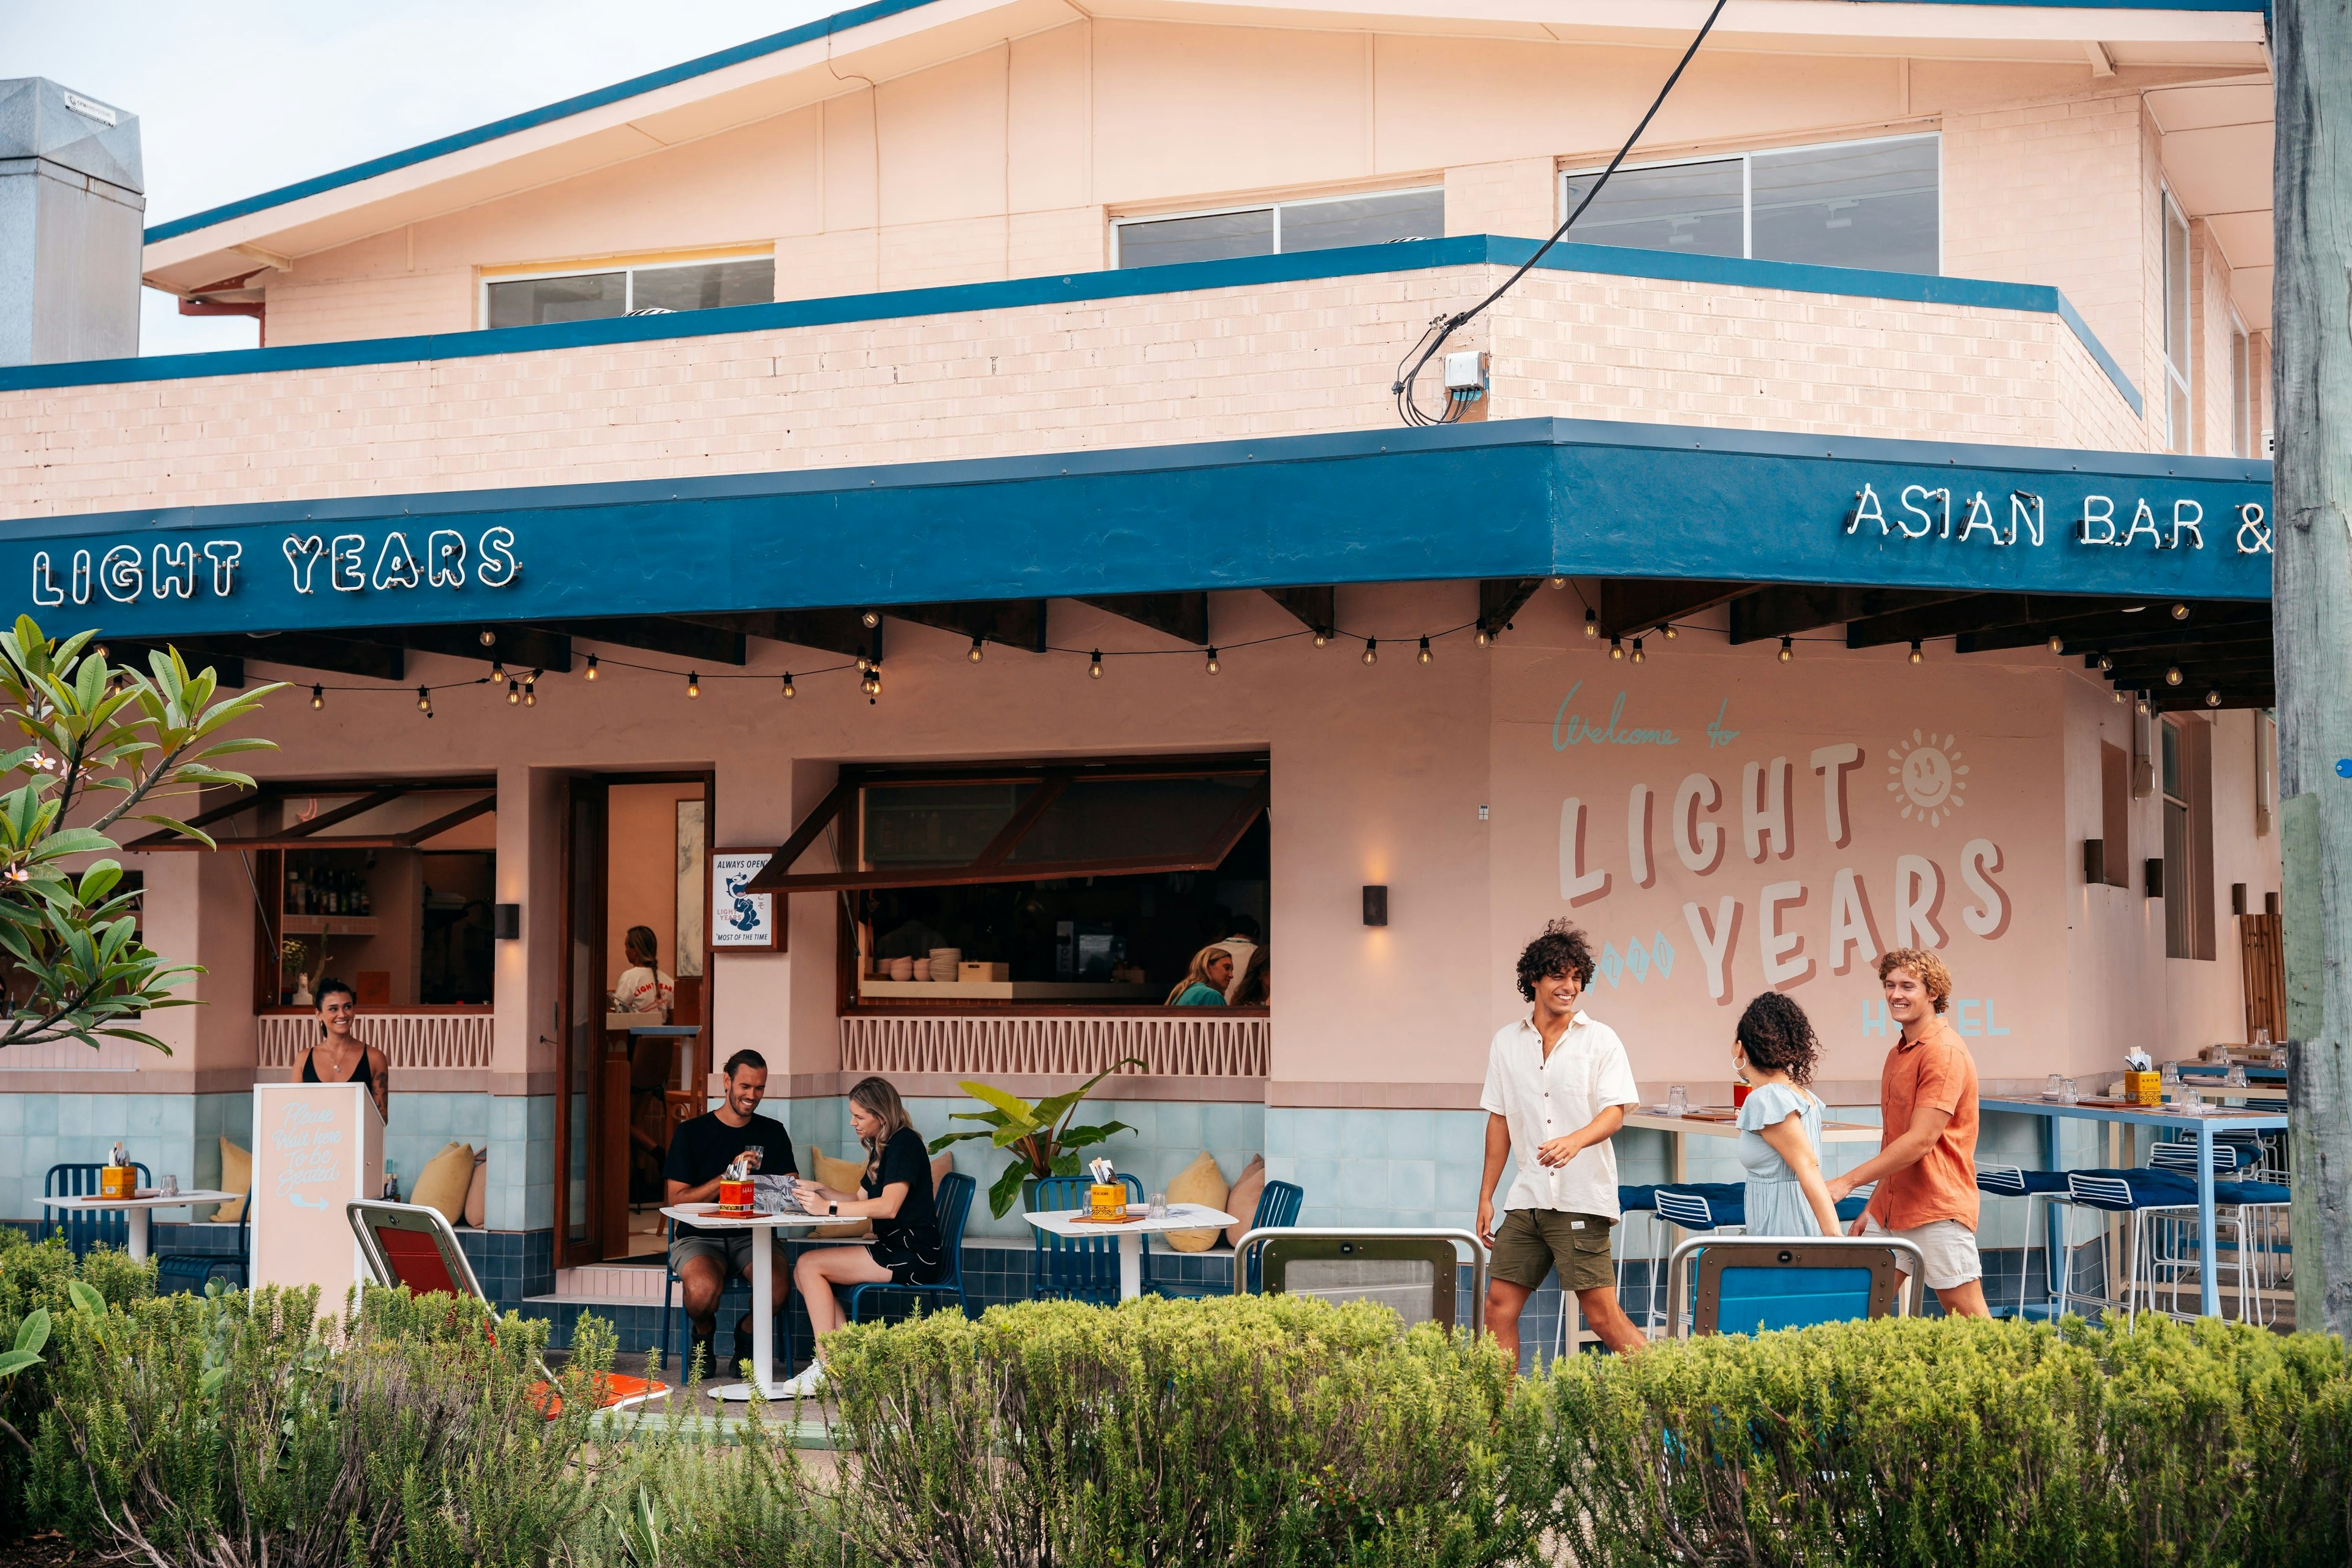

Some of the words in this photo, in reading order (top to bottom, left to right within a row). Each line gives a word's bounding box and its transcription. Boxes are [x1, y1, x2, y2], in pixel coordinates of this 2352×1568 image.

[1846, 483, 2044, 546] ASIAN
[2081, 495, 2204, 549] BAR
[2236, 503, 2272, 554] &
[32, 540, 243, 606] LIGHT
[282, 526, 516, 593] YEARS
[1552, 679, 1680, 752] Welcome
[1706, 696, 1740, 748] to
[1559, 742, 1866, 908] LIGHT
[1683, 838, 2012, 1006] YEARS
[1862, 999, 2010, 1037] HEL
[272, 1126, 311, 1151] Wait
[313, 1126, 342, 1145] here
[281, 1102, 335, 1127] Please
[276, 1159, 341, 1197] Seated
[284, 1148, 308, 1169] To
[309, 1145, 333, 1166] be
